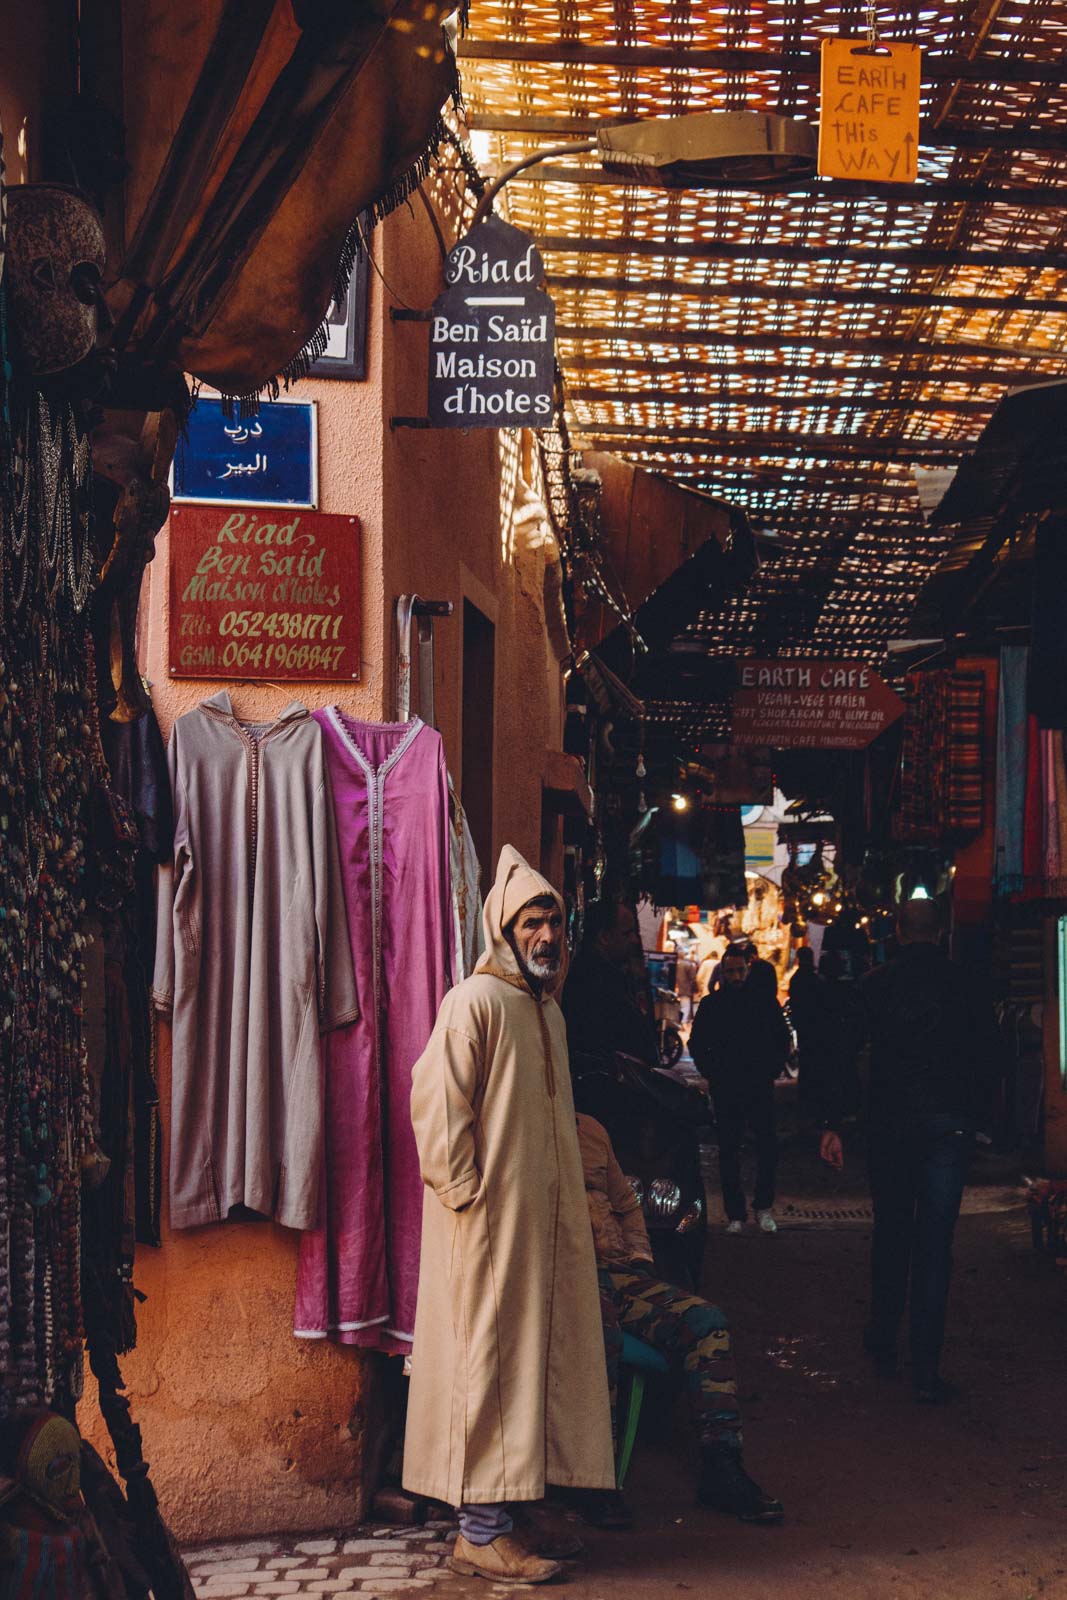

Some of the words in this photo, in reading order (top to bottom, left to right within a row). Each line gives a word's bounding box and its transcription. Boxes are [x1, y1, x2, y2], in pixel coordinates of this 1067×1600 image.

[837, 65, 907, 90] EARTH
[834, 92, 902, 116] CAFE
[837, 148, 901, 178] WAY
[446, 243, 536, 285] Riad
[432, 316, 480, 343] Ben
[487, 315, 548, 343] Saïd
[435, 352, 537, 379] Maison
[443, 384, 551, 414] d'hotes
[216, 453, 268, 478] البير
[217, 512, 316, 546] Riad
[195, 546, 252, 576] Ben
[182, 574, 266, 603] Maison
[218, 610, 344, 640] 0524381711
[222, 640, 347, 671] 0641968847
[741, 666, 812, 688] EARTH
